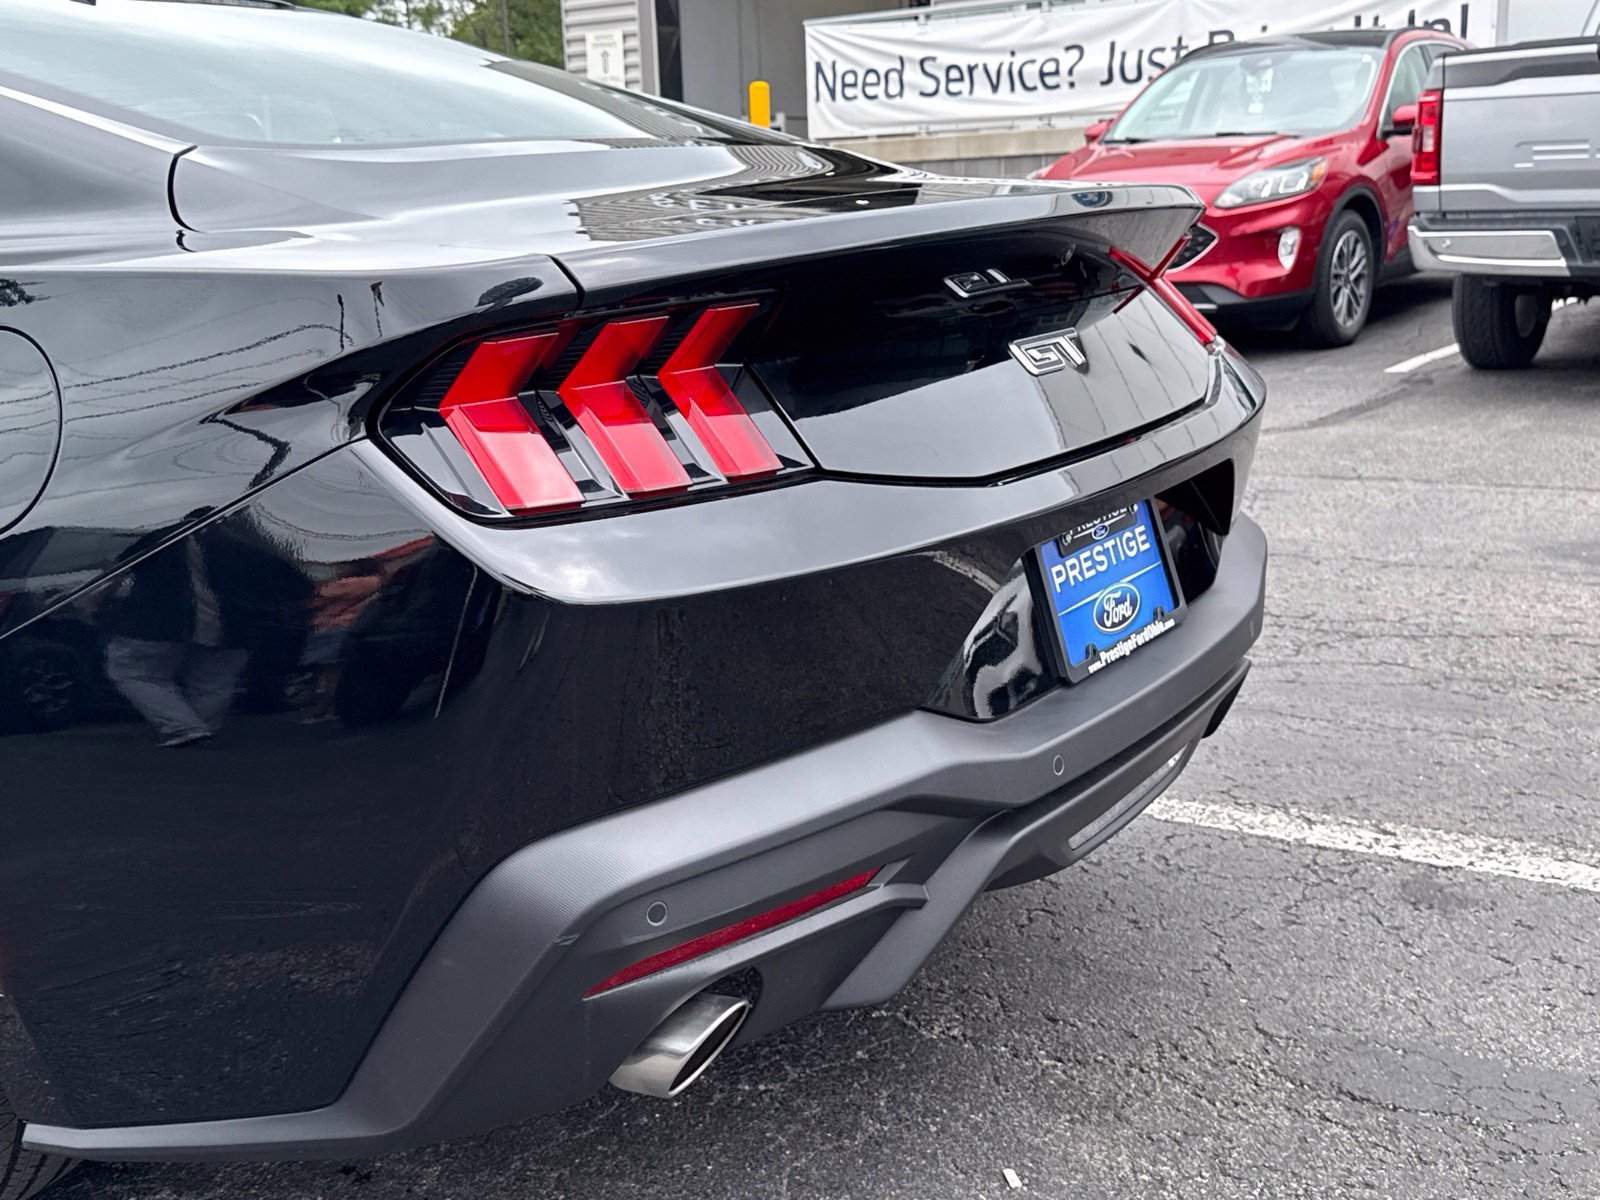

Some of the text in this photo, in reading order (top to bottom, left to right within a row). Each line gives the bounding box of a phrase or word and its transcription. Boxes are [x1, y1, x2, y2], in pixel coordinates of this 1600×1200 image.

[814, 55, 905, 103] Need
[918, 44, 1085, 98] Service?
[1008, 327, 1087, 375] GT
[1051, 525, 1151, 593] PRESTIGE
[1103, 591, 1133, 628] Ford
